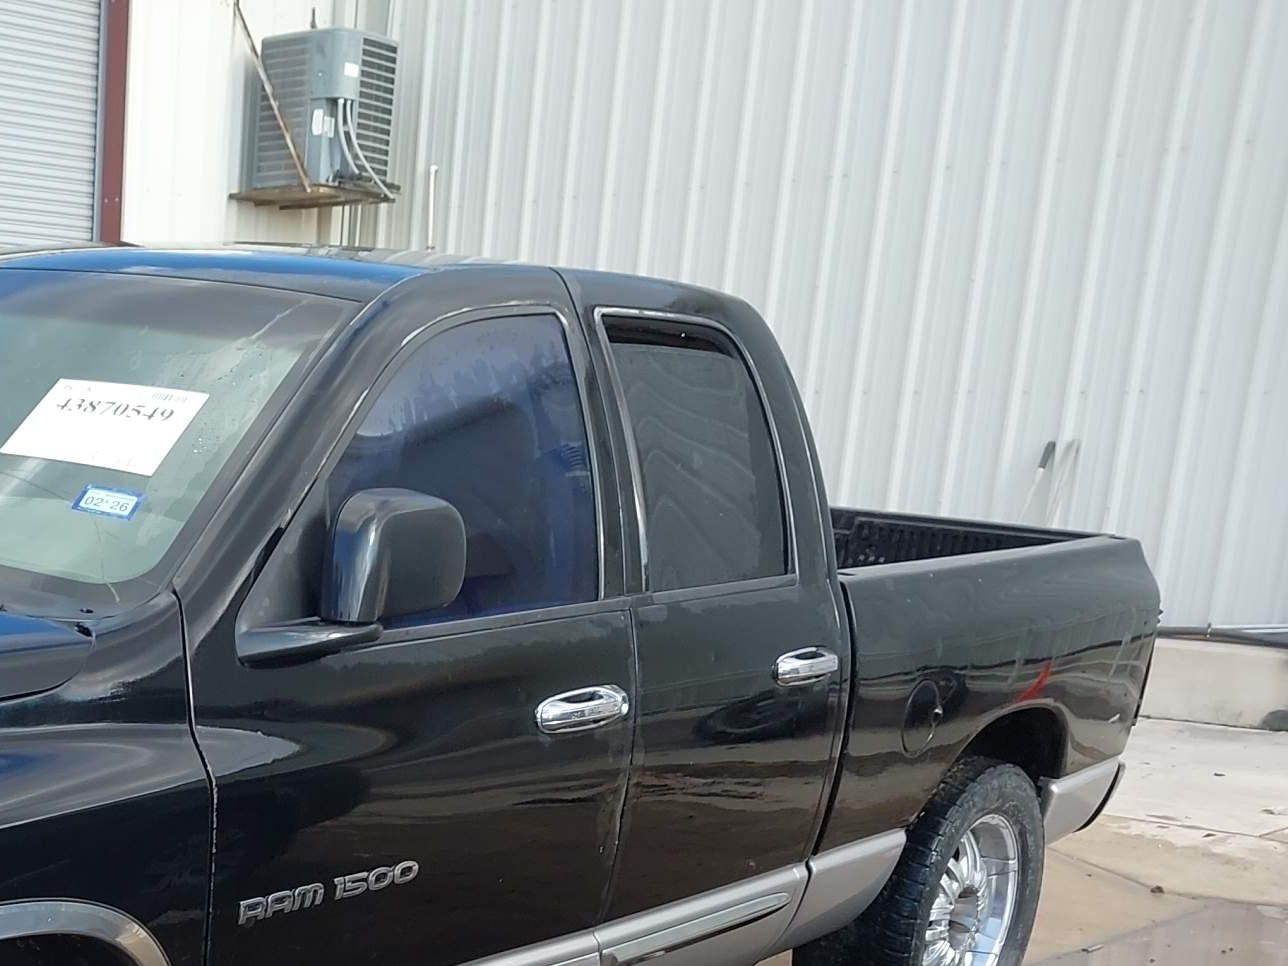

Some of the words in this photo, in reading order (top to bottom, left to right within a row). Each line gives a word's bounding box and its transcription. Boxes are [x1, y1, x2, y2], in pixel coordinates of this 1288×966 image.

[57, 398, 175, 421] 43870549
[237, 882, 325, 926] RAM
[333, 860, 420, 901] 1500
